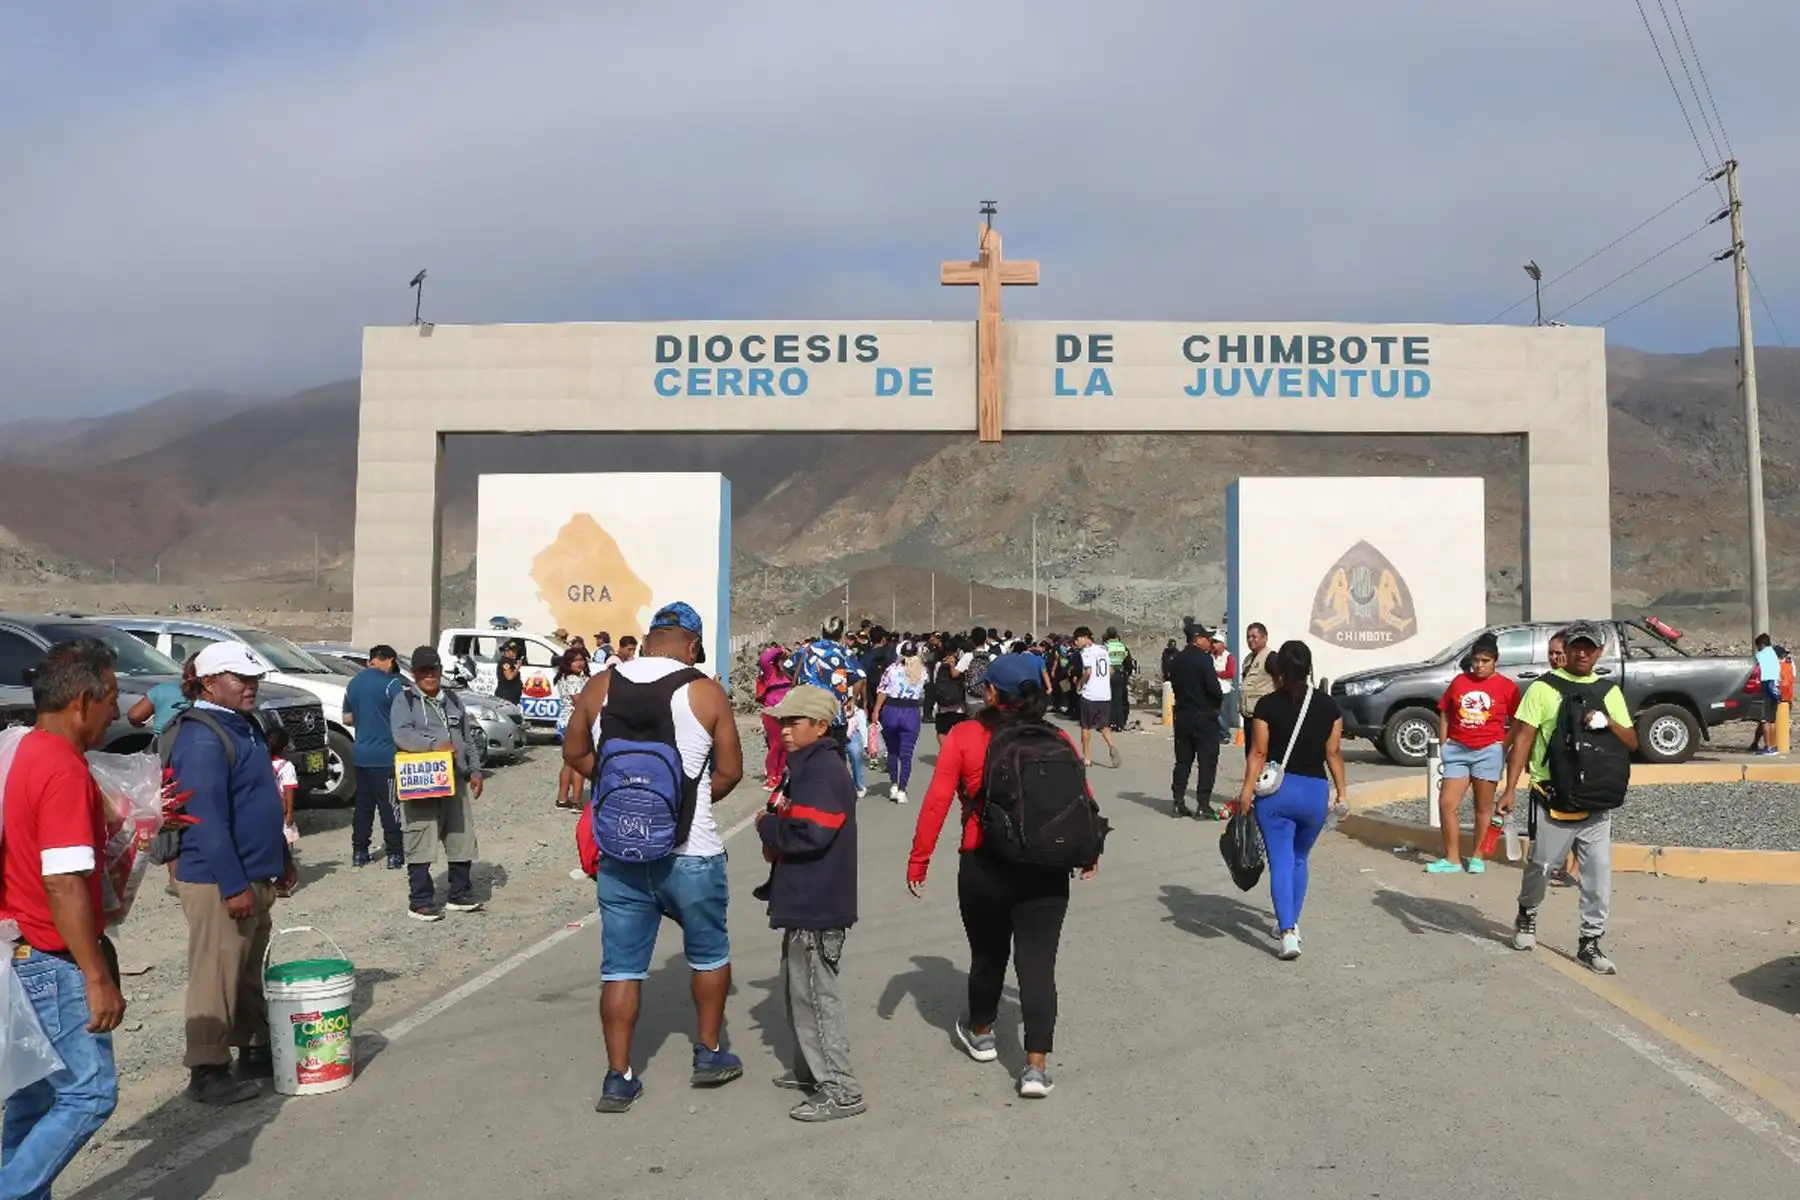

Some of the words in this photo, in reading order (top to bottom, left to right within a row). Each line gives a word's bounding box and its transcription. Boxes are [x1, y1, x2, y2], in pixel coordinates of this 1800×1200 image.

[655, 335, 880, 363] DIOCESIS
[1056, 334, 1113, 363] DE
[1183, 334, 1429, 365] CHIMBOTE
[654, 367, 808, 396] CERRO
[875, 367, 933, 396] DE
[1055, 368, 1113, 396] LA
[1183, 368, 1431, 398] JUVENTUD
[567, 584, 612, 602] GRA
[1336, 631, 1394, 642] CHIMBOTE
[1095, 657, 1108, 678] 10
[401, 774, 435, 787] CARIBE
